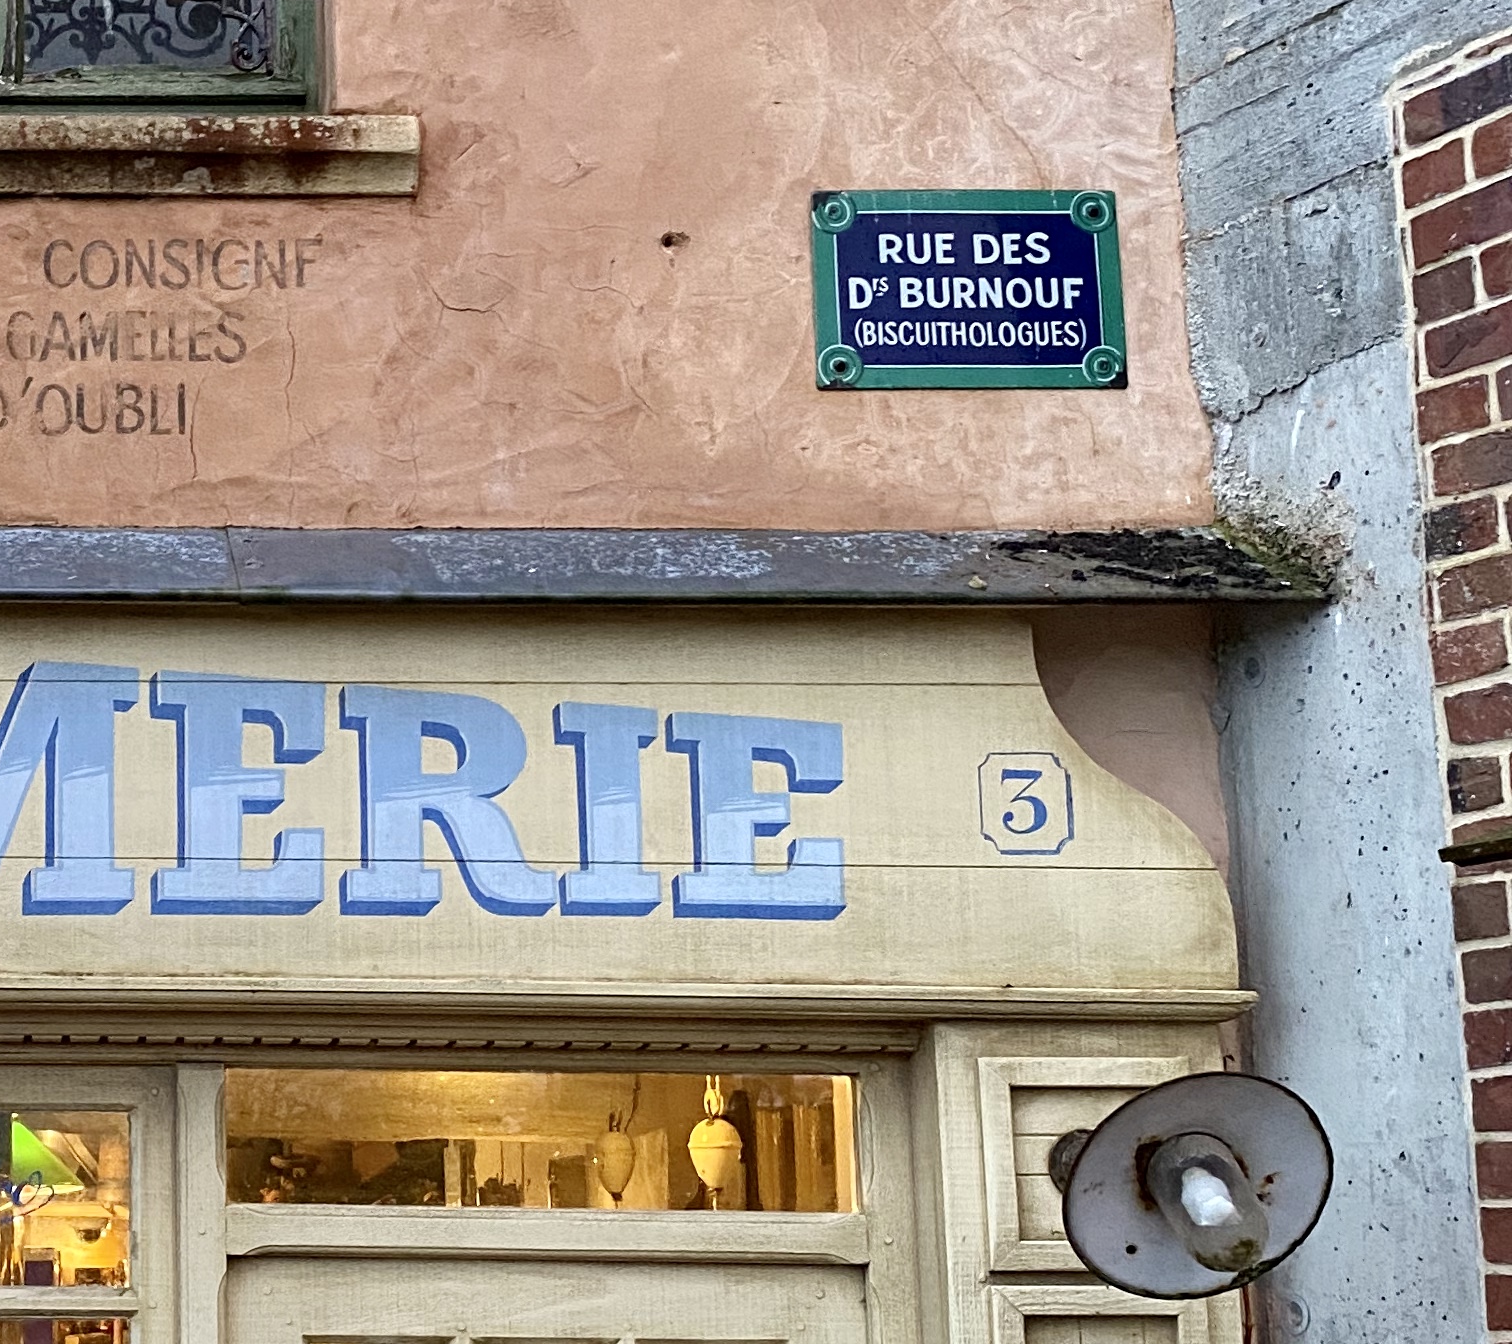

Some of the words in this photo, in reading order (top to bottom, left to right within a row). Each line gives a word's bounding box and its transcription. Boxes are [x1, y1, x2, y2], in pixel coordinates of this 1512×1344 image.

[878, 233, 956, 265] RUE
[973, 232, 1052, 265] DES
[899, 277, 1085, 309] BURNOUF
[6, 310, 247, 364] GAMELLES
[854, 317, 1088, 350] (BISCUITHOLOGUES)
[997, 766, 1049, 836] 3
